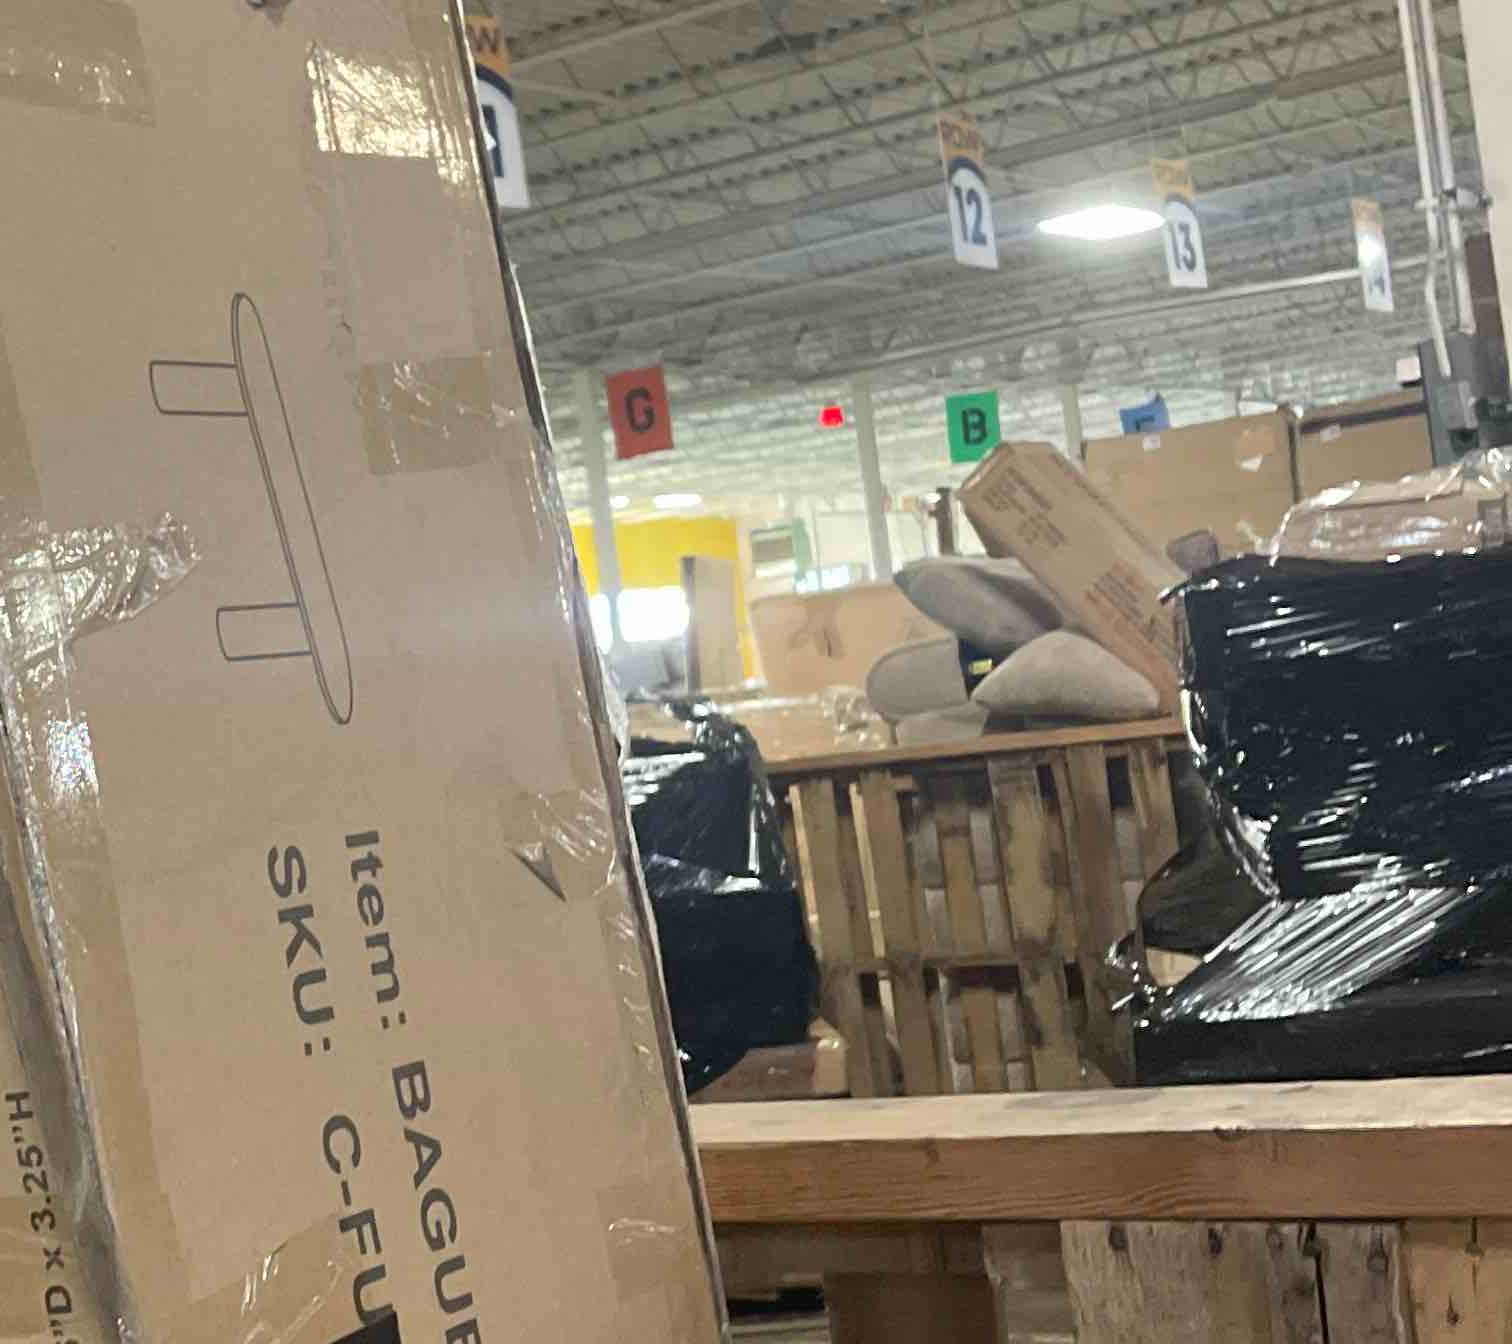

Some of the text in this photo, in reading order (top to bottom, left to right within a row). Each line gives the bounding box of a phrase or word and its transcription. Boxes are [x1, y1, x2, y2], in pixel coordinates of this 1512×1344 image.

[953, 185, 987, 246] 12
[1168, 222, 1196, 271] 13
[624, 387, 655, 432] G
[961, 408, 987, 445] B
[267, 845, 335, 1056] SKU:
[345, 830, 406, 1029] Item:
[5, 1090, 56, 1232] 3.25"H
